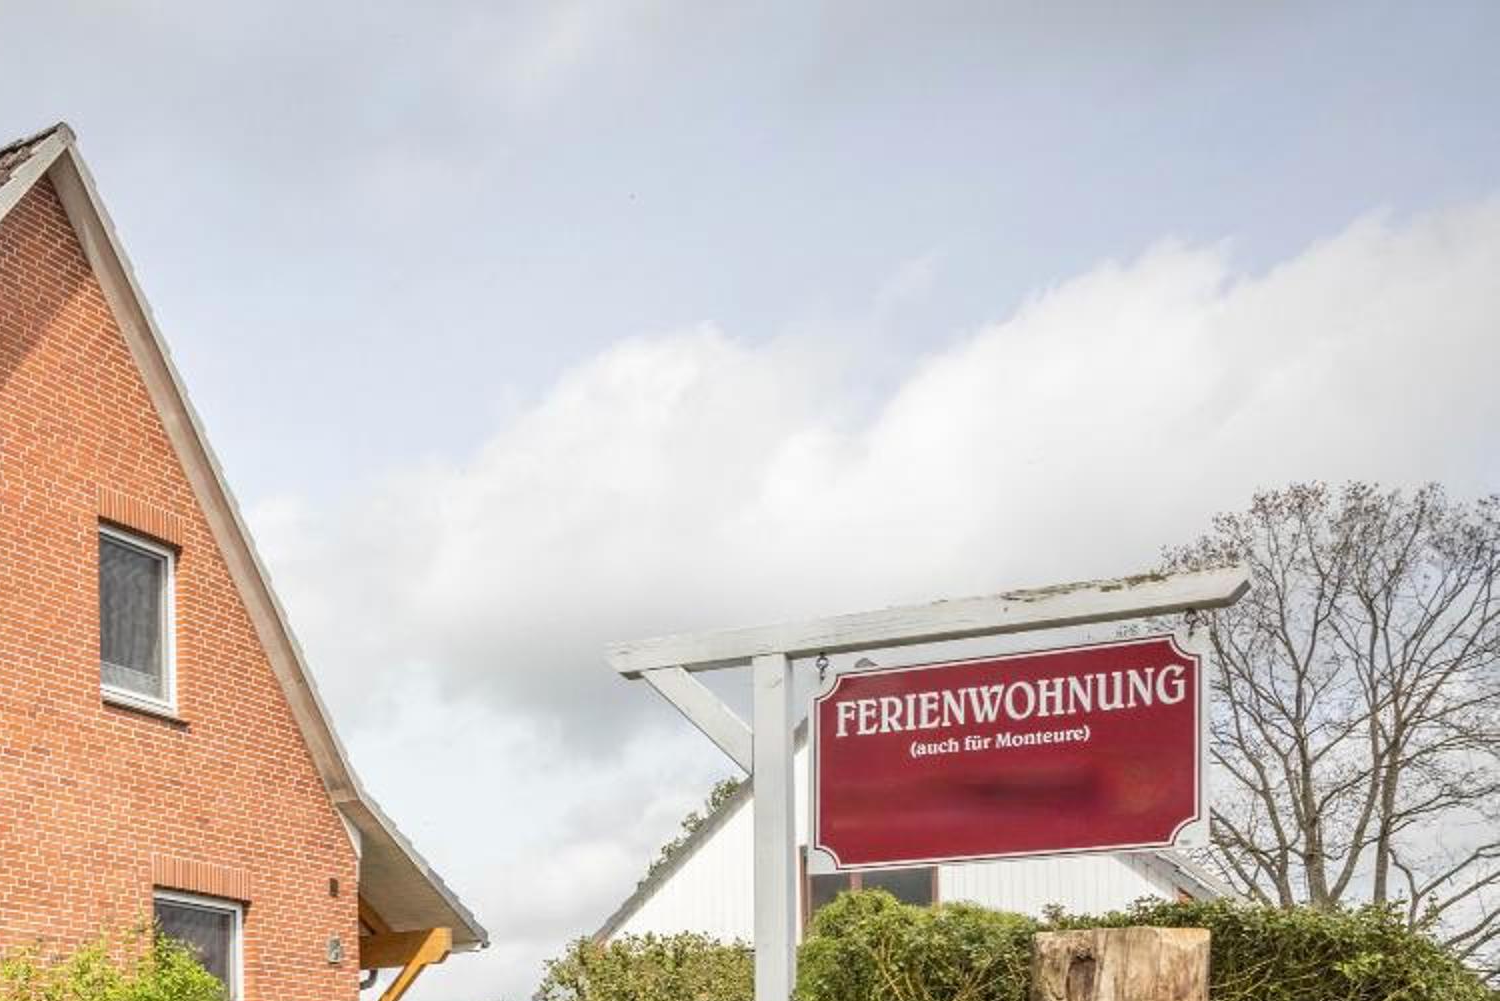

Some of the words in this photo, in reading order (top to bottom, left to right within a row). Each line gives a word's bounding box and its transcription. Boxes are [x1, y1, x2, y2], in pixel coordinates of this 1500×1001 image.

[835, 664, 1187, 737] FERIENWOHNUNG
[910, 738, 959, 758] (auch
[964, 735, 992, 751] für
[995, 725, 1091, 749] Monteure)
